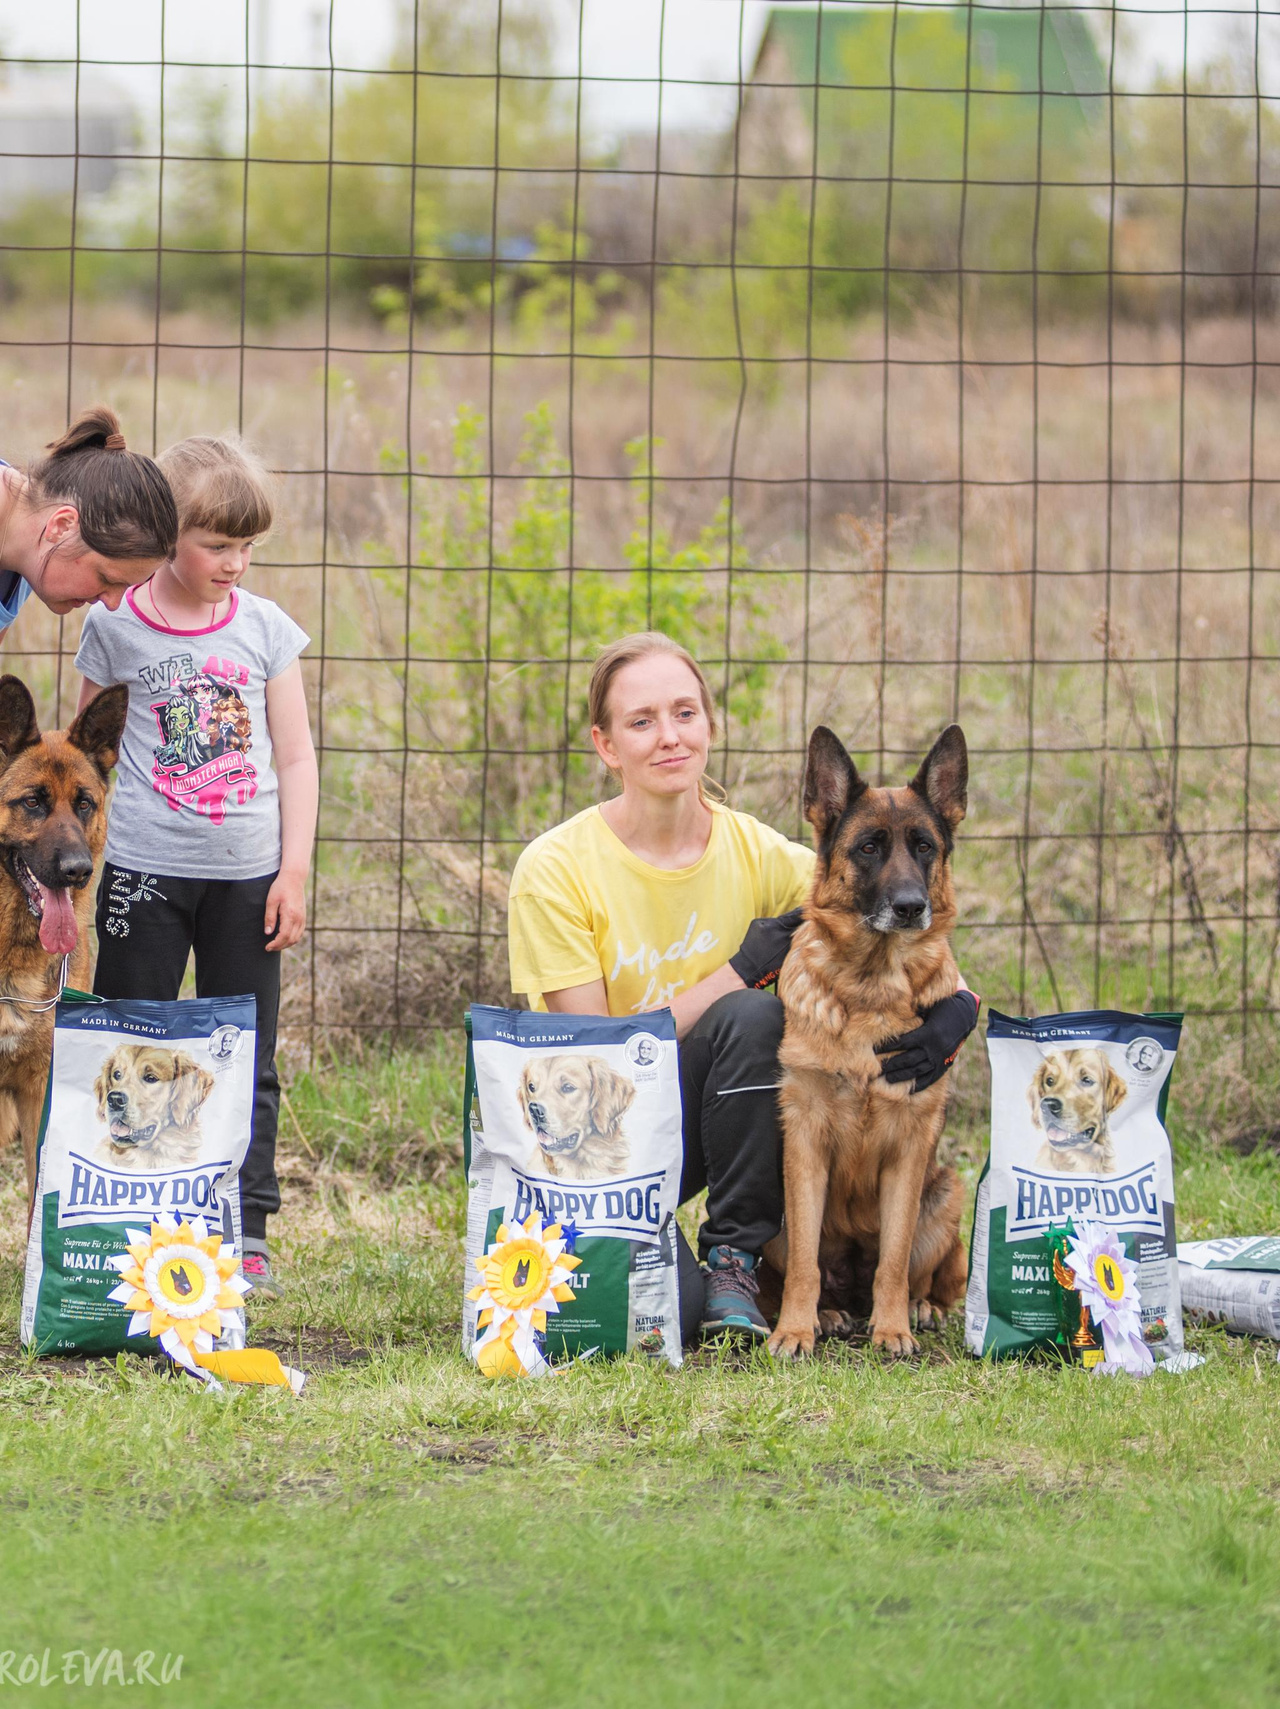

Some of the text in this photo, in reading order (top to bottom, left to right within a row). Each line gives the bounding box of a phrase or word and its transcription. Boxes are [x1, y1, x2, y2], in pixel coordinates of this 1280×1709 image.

[138, 653, 250, 695] WE ARE
[175, 754, 239, 791] MONSTER HIGH
[610, 911, 719, 982] Made
[630, 976, 685, 1014] for
[81, 1018, 107, 1026] MADE
[123, 1022, 168, 1035] GERMANY
[496, 1031, 515, 1040] MADE
[529, 1034, 574, 1042] GERMANY
[67, 1163, 225, 1210] HAPPY DOG
[1016, 1174, 1158, 1221] HAPPY DOG
[511, 1178, 661, 1225] HAPPY DOG
[64, 1237, 90, 1248] Supreme
[91, 1240, 101, 1248] Fit
[102, 1240, 112, 1250] &
[1012, 1251, 1041, 1262] Supreme
[63, 1251, 100, 1270] MAXI
[1011, 1265, 1050, 1281] MAXI
[635, 1315, 664, 1326] NATURAL
